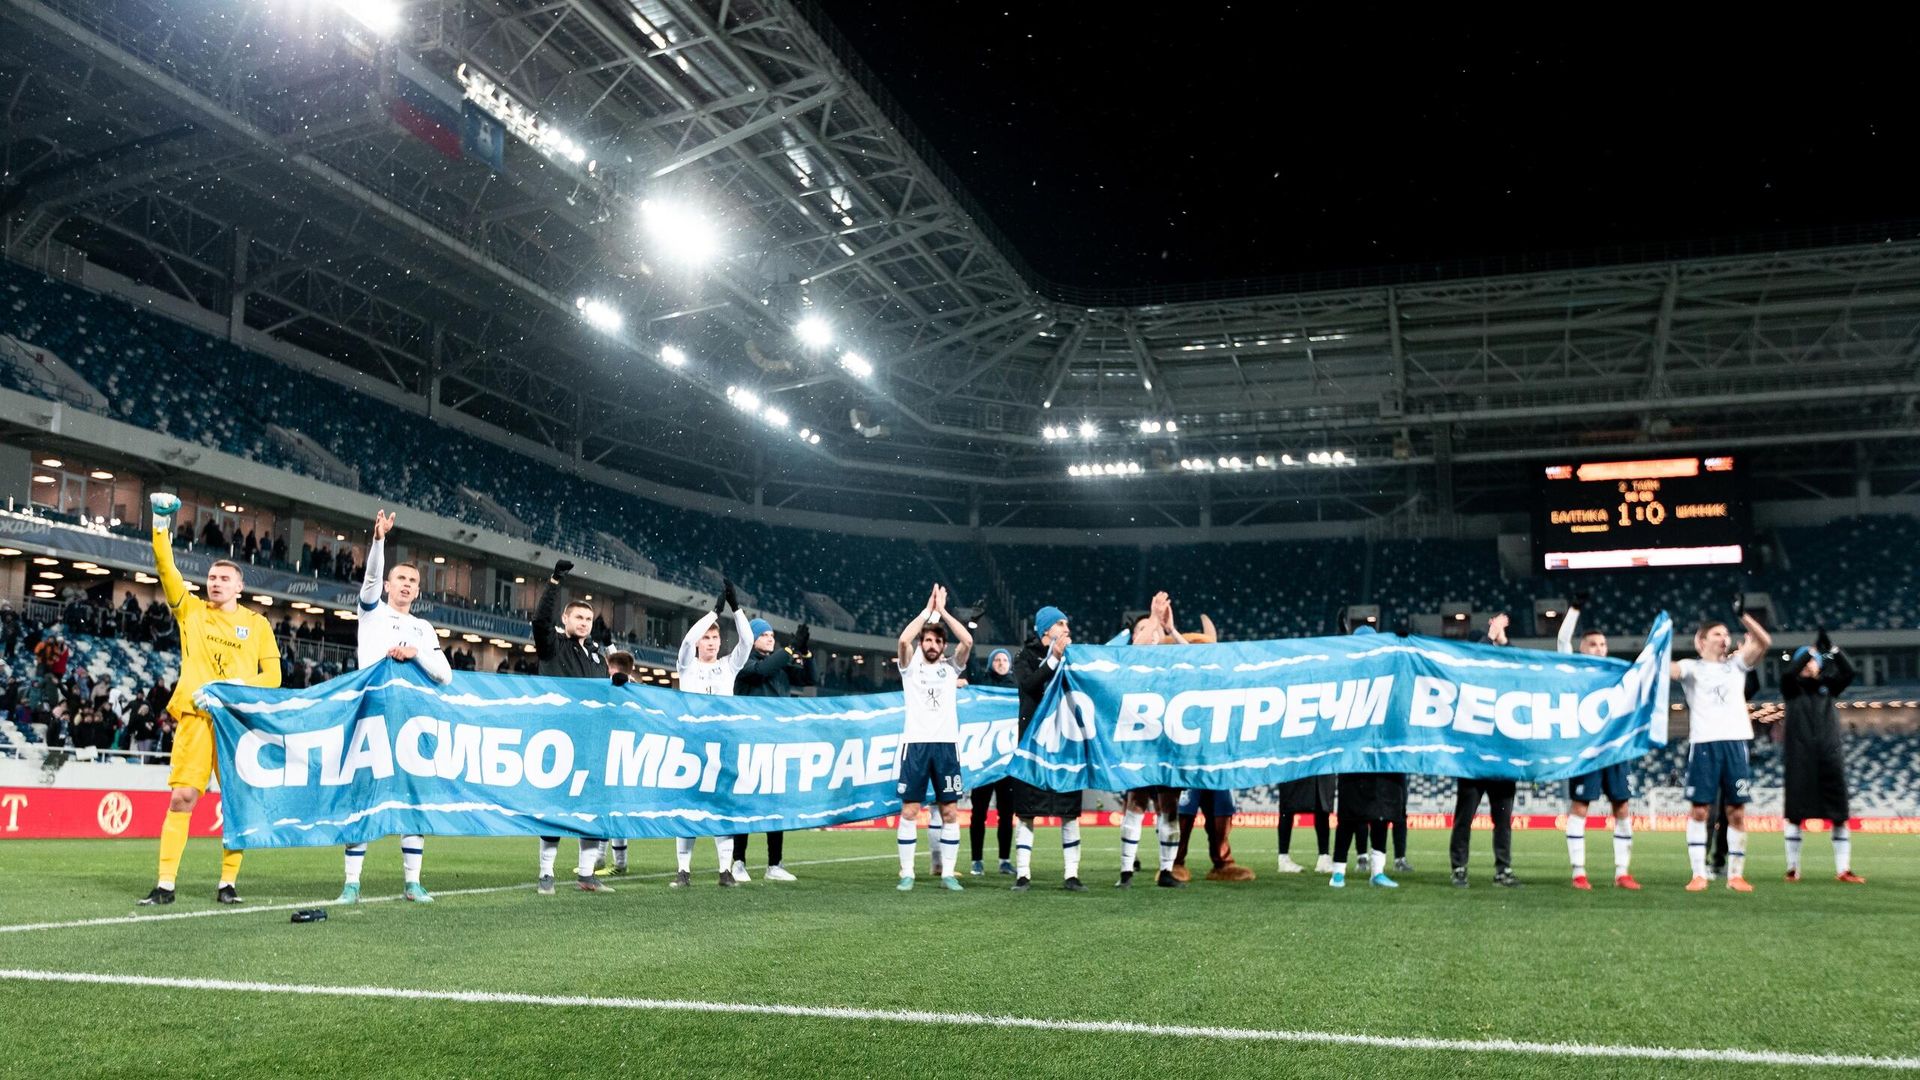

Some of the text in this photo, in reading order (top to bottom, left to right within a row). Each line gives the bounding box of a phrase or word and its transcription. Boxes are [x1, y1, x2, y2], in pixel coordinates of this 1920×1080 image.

[1551, 508, 1610, 525] БАЛТИКА
[1617, 501, 1666, 526] 1:0
[1113, 675, 1394, 745] ВСТРЕЧИ
[235, 715, 589, 796] СПАСИБО,
[604, 730, 722, 793] МЫ
[943, 774, 962, 793] 18
